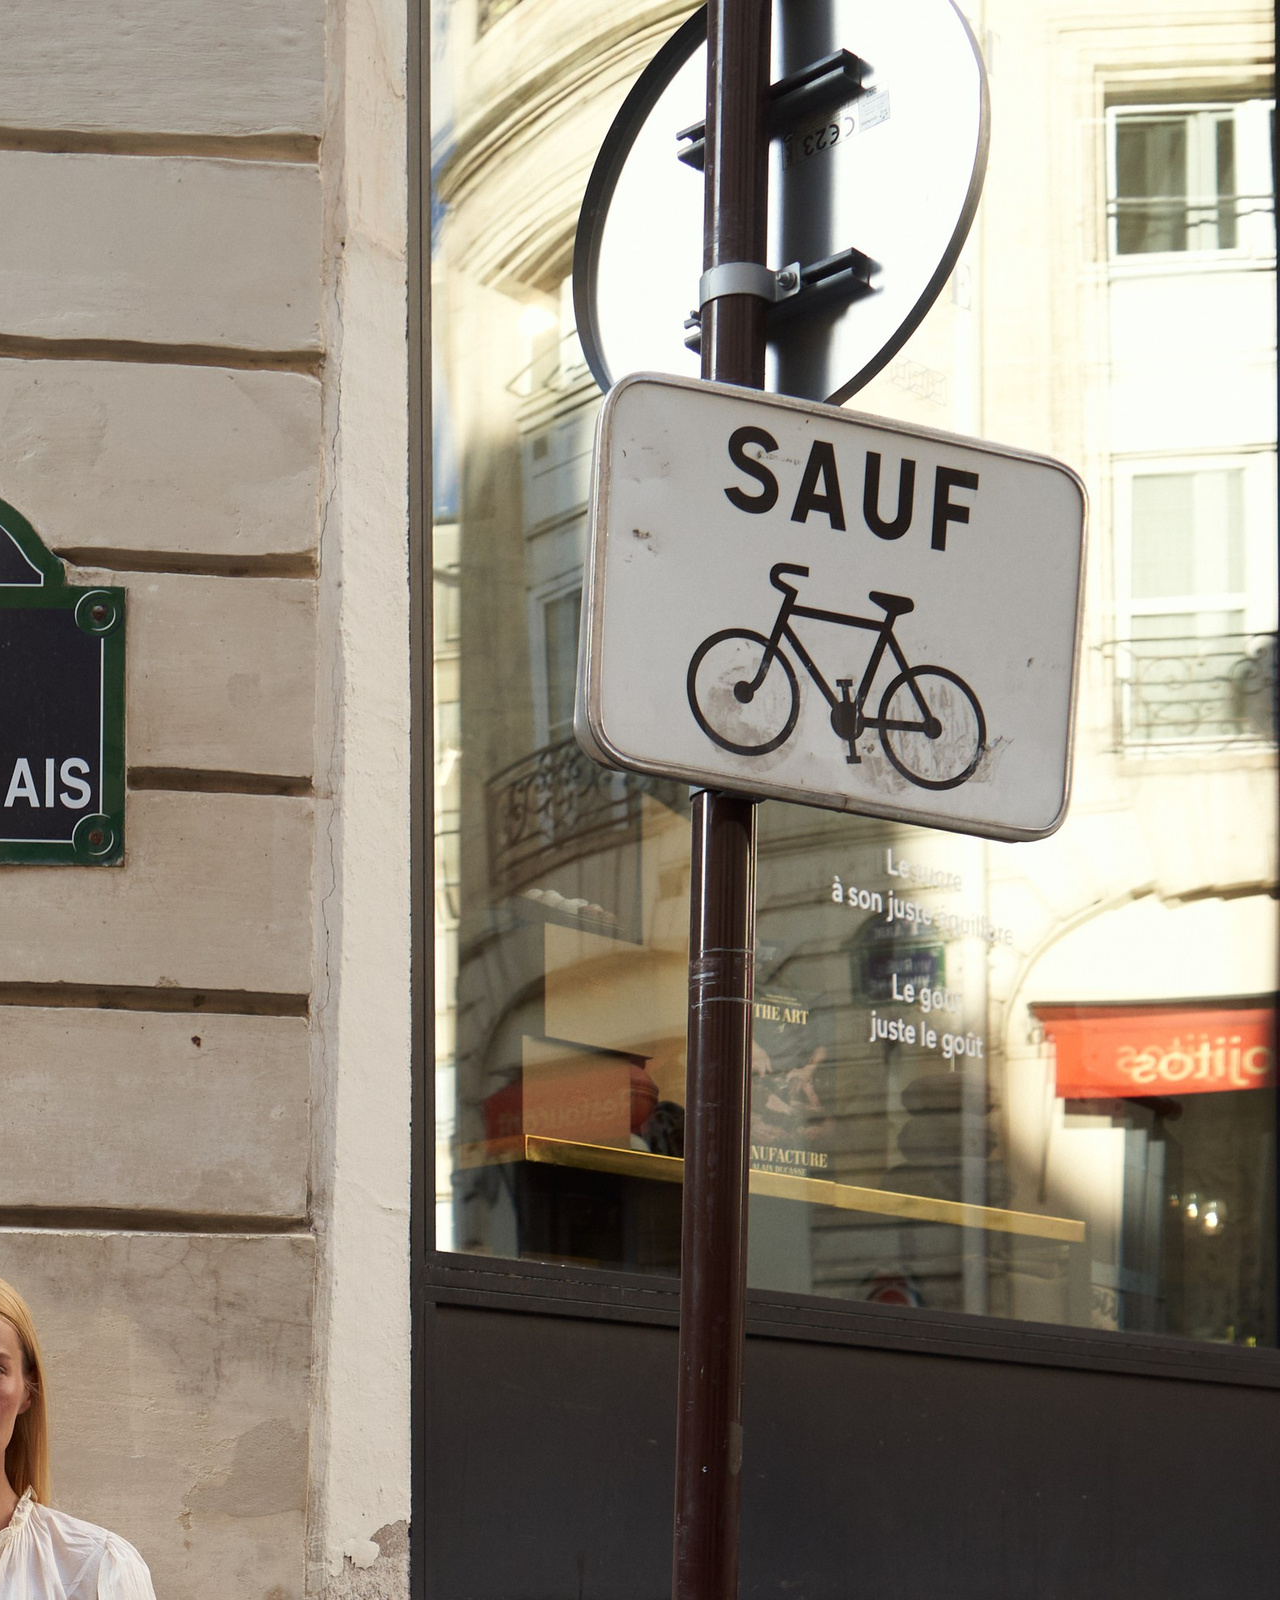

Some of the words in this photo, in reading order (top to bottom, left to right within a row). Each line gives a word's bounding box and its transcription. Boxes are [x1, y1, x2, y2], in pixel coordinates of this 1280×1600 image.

[723, 425, 980, 553] SAUF
[886, 848, 911, 878] Le
[831, 875, 844, 903] à
[848, 886, 883, 913] son
[886, 890, 932, 926] juste
[892, 973, 915, 1003] Le
[753, 1003, 780, 1021] THE
[783, 1007, 809, 1025] ART
[869, 1010, 916, 1043] juste
[921, 1022, 937, 1049] le
[942, 1032, 984, 1059] goût
